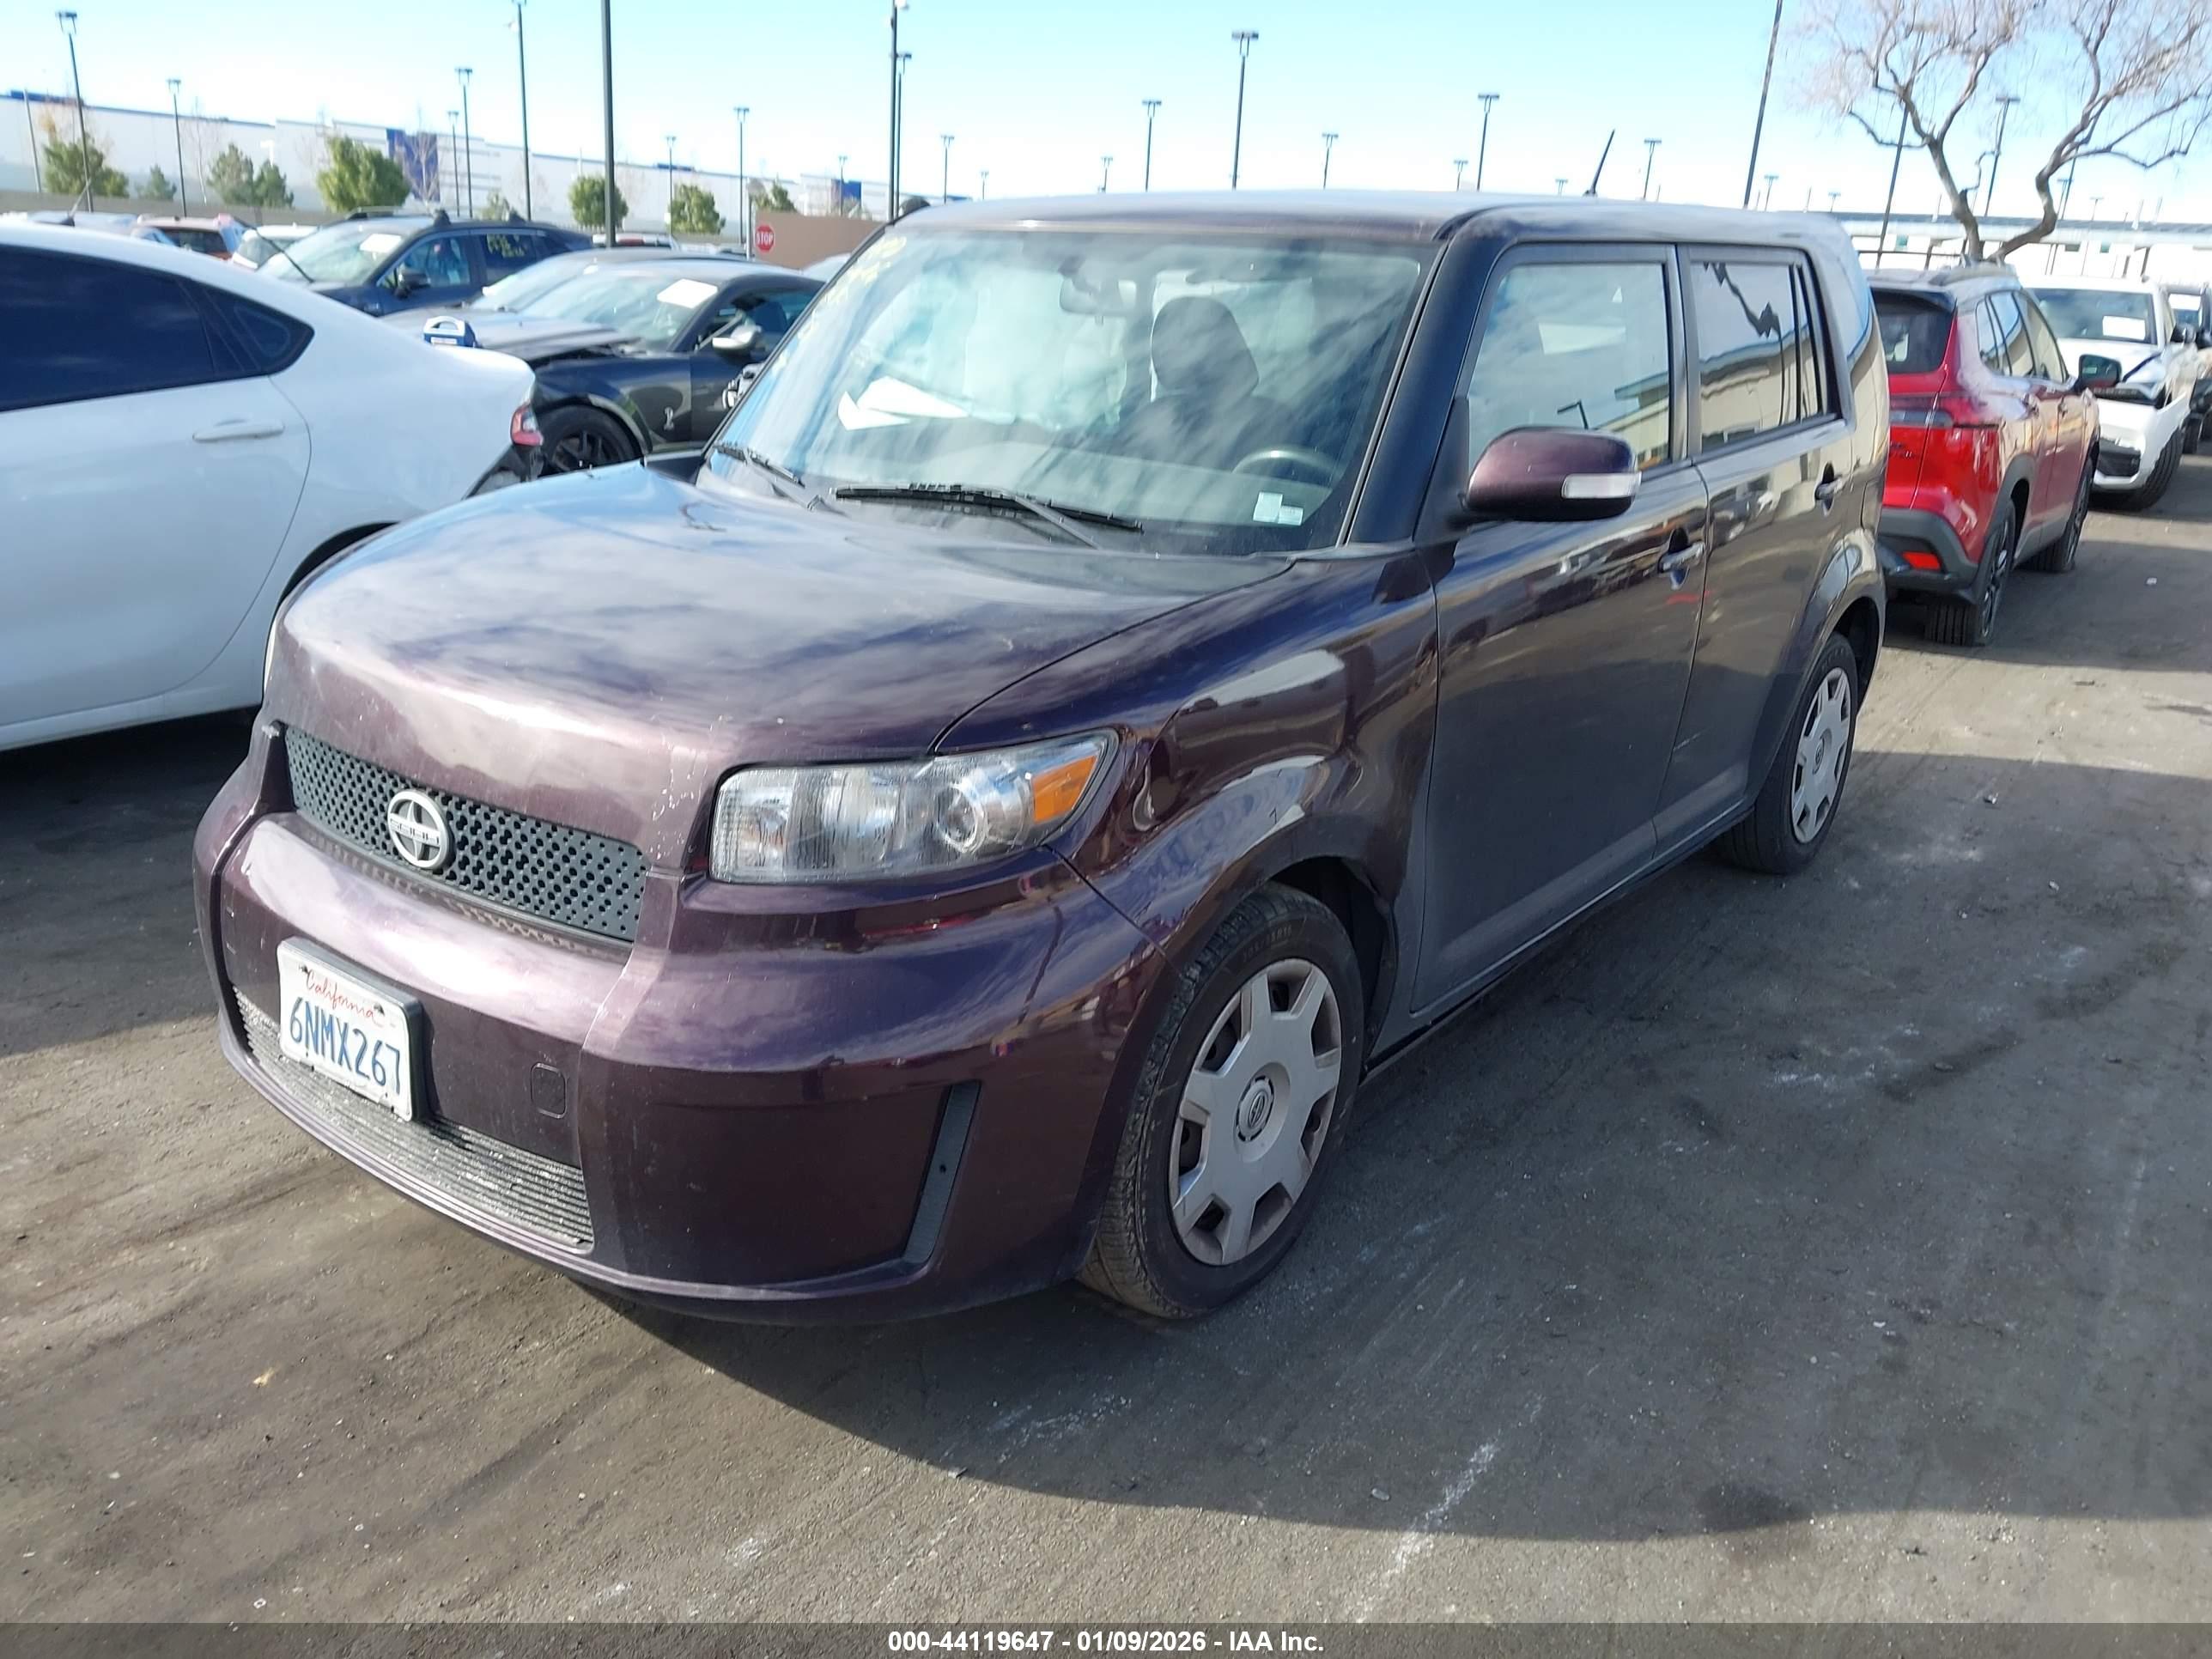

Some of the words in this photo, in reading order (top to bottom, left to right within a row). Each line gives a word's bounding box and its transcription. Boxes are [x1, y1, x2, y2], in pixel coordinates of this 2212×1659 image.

[755, 233, 775, 245] STOP
[305, 969, 378, 1021] California
[290, 997, 400, 1095] 6NMX267
